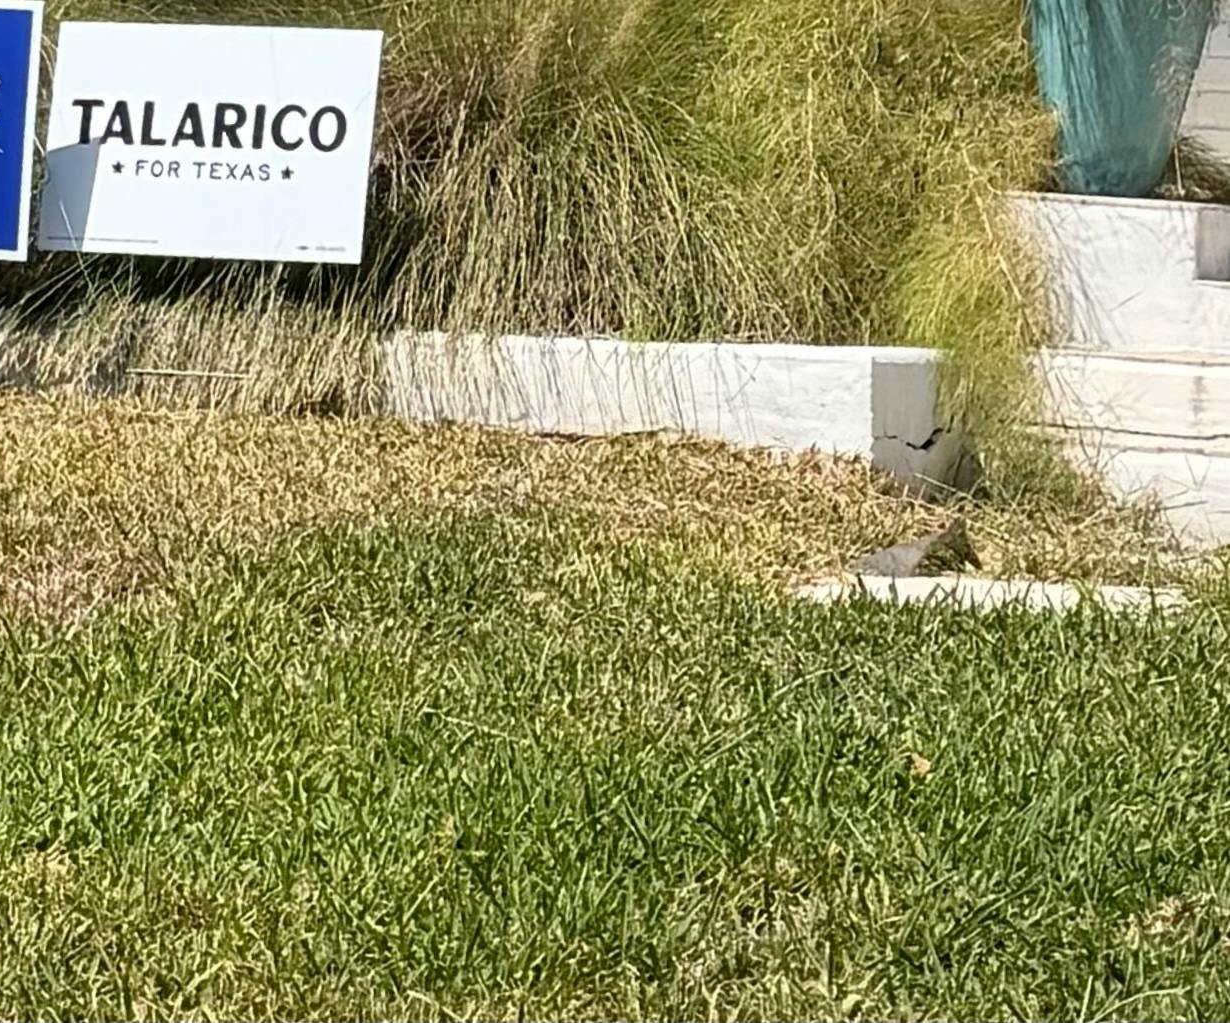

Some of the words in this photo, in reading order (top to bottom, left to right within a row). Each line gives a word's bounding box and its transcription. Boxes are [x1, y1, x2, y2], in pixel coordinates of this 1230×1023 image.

[72, 99, 347, 152] TALARICO
[135, 160, 181, 178] FOR
[192, 161, 271, 182] TEXAS
